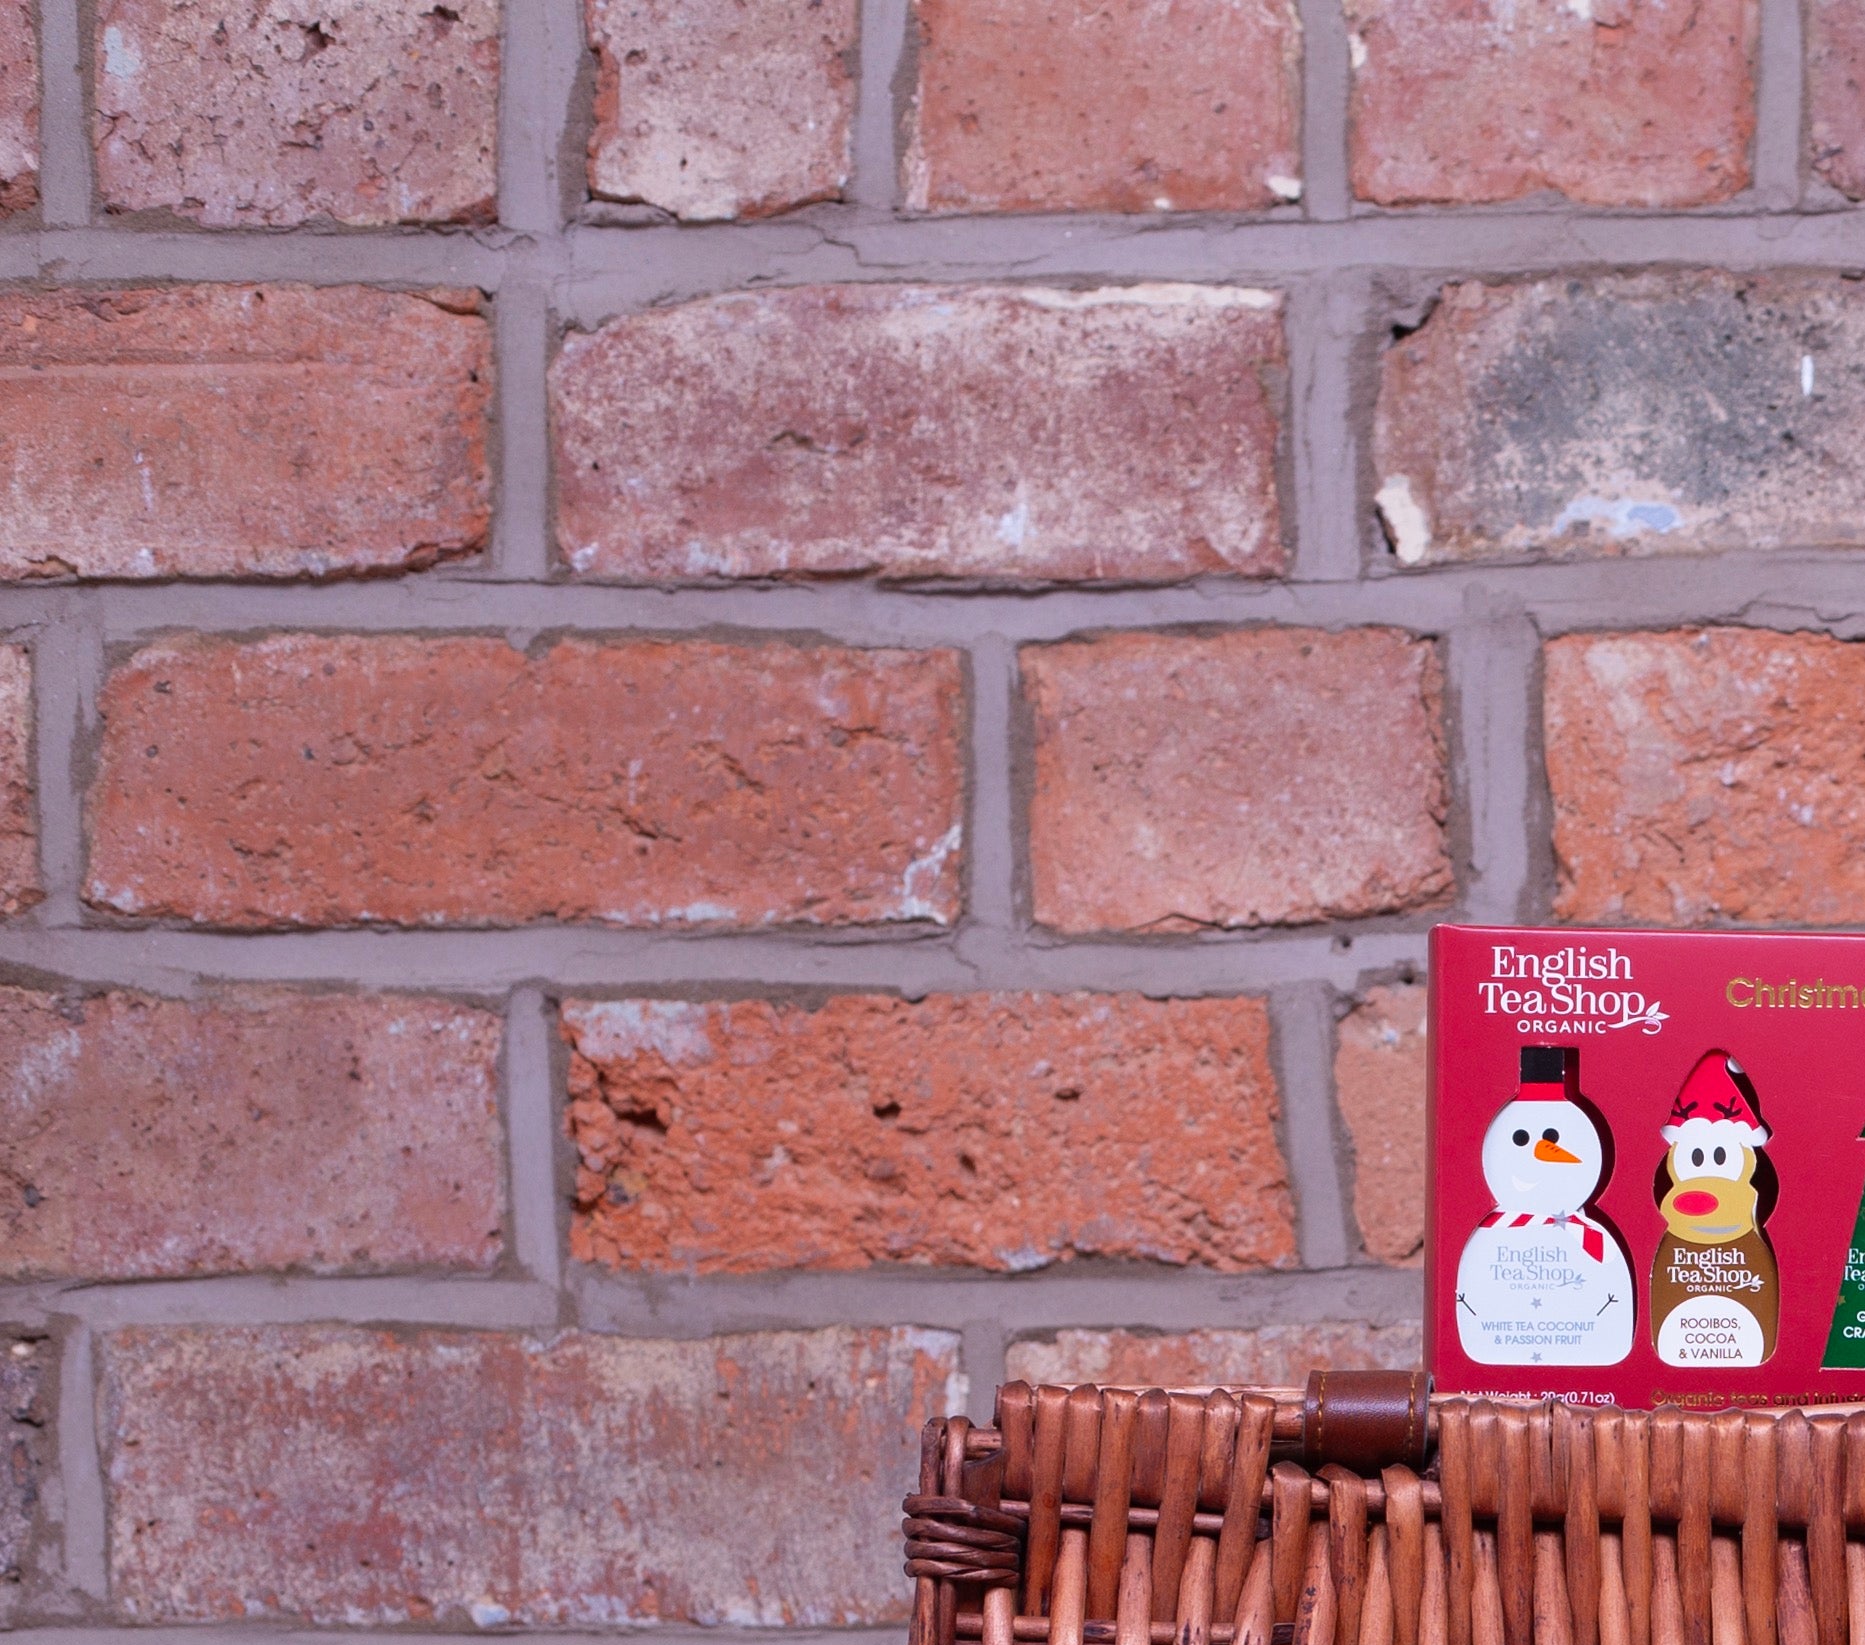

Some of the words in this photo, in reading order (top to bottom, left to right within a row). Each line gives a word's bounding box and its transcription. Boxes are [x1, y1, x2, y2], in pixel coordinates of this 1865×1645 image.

[1490, 946, 1634, 988] English
[1478, 982, 1547, 1016] Tea
[1550, 983, 1648, 1024] Shop
[1516, 1018, 1607, 1035] ORGANIC
[1680, 1317, 1742, 1330] ROOIBOS,
[1684, 1333, 1737, 1344] COCOA
